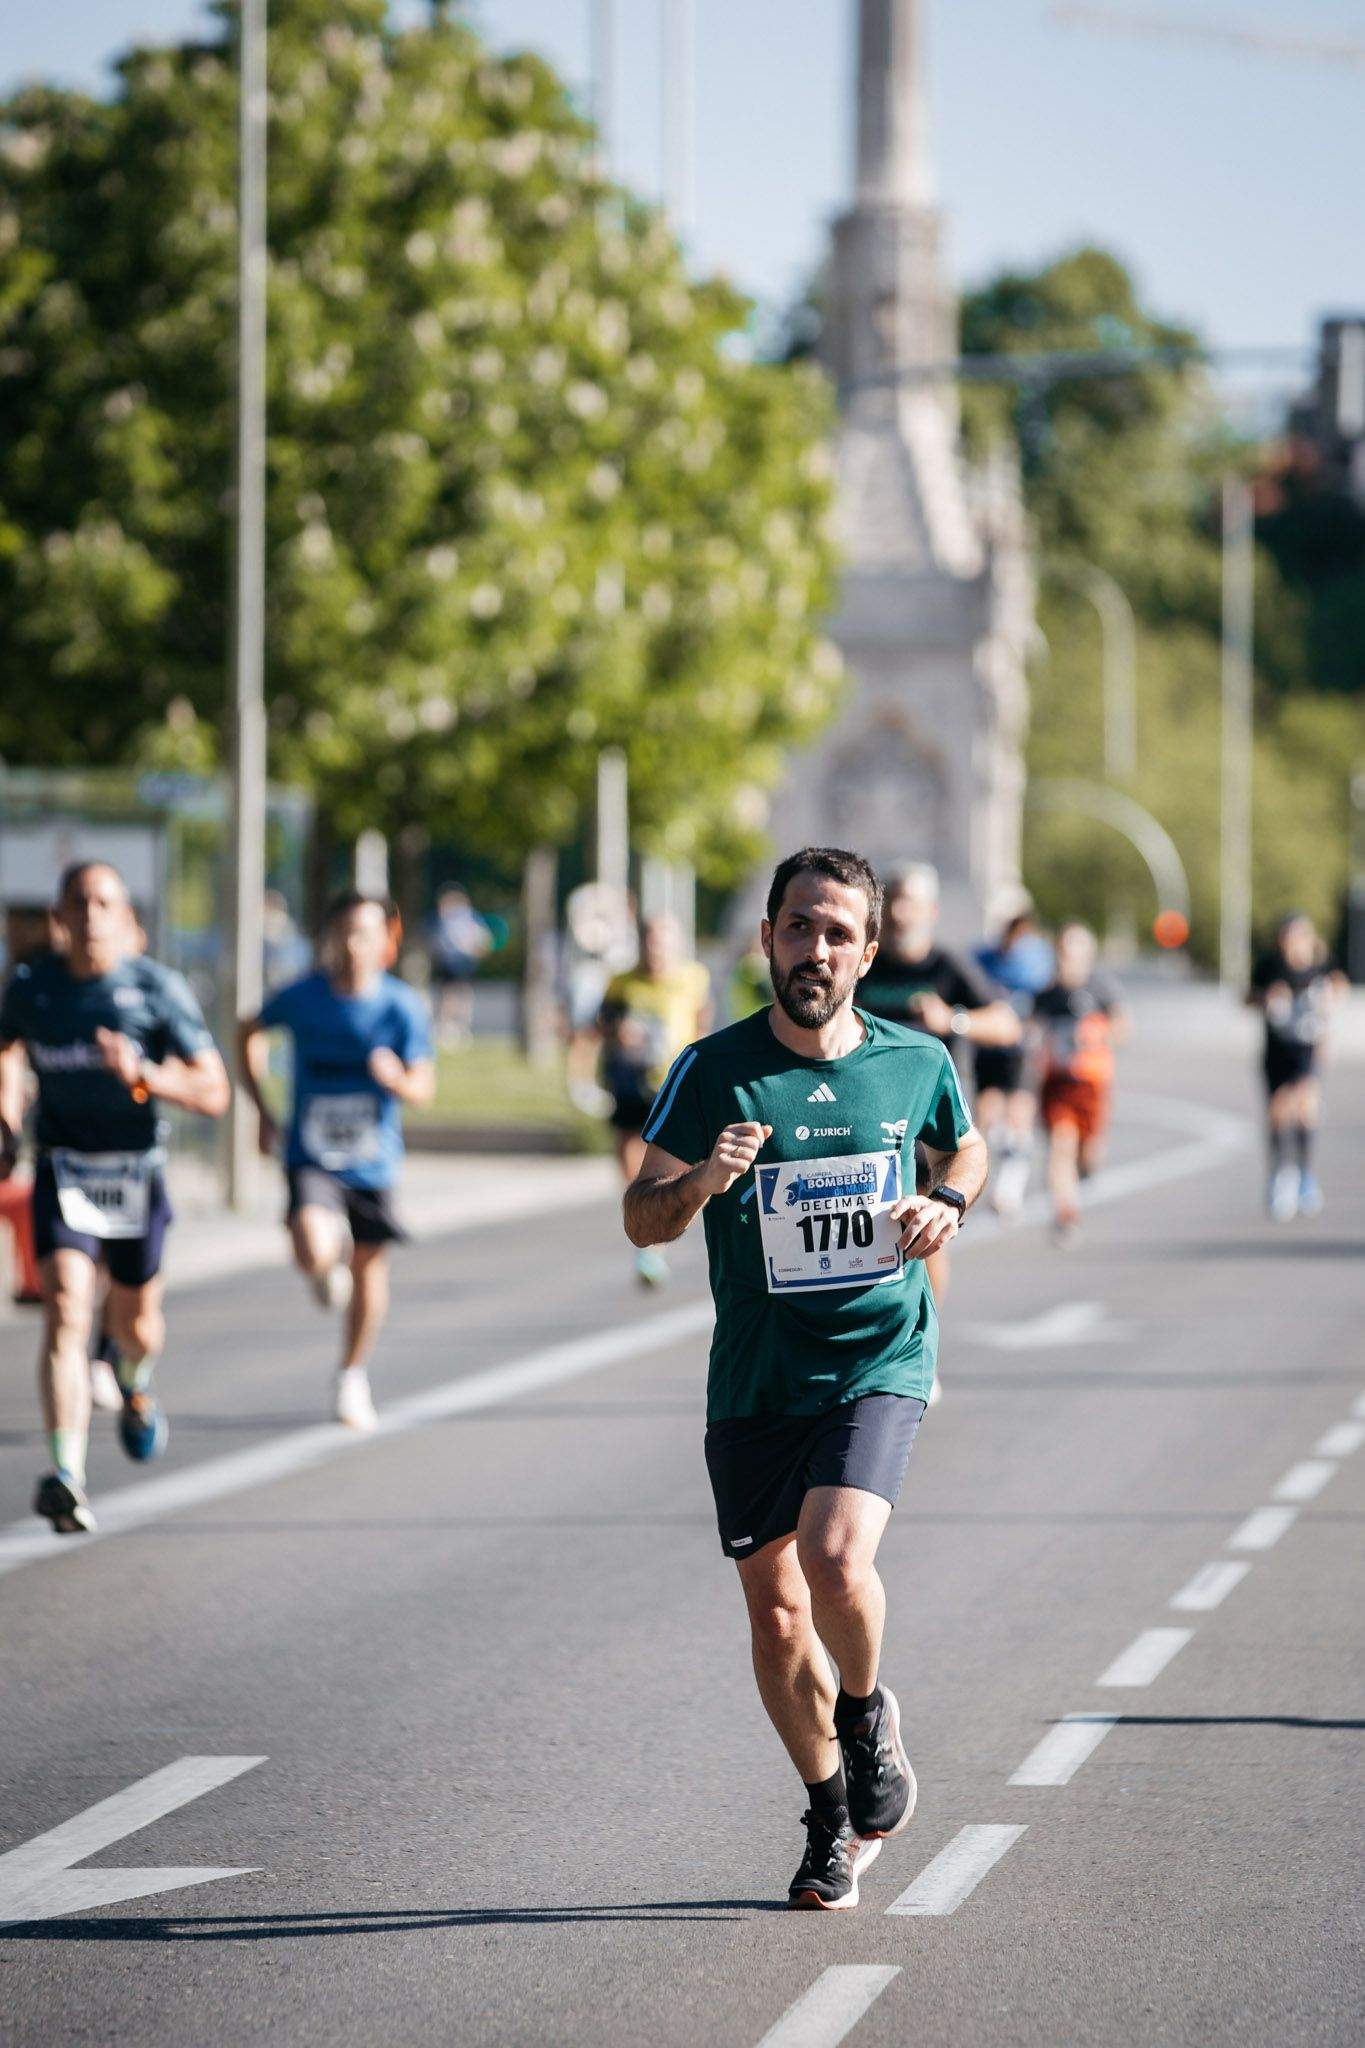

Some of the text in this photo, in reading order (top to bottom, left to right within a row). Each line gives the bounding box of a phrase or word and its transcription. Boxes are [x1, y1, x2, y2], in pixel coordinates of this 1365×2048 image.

[813, 1127, 852, 1137] ZURICH
[806, 1173, 875, 1189] BOMBEROS
[846, 1182, 876, 1194] MADRID
[801, 1194, 875, 1212] DECIMAS
[796, 1209, 873, 1253] 1770
